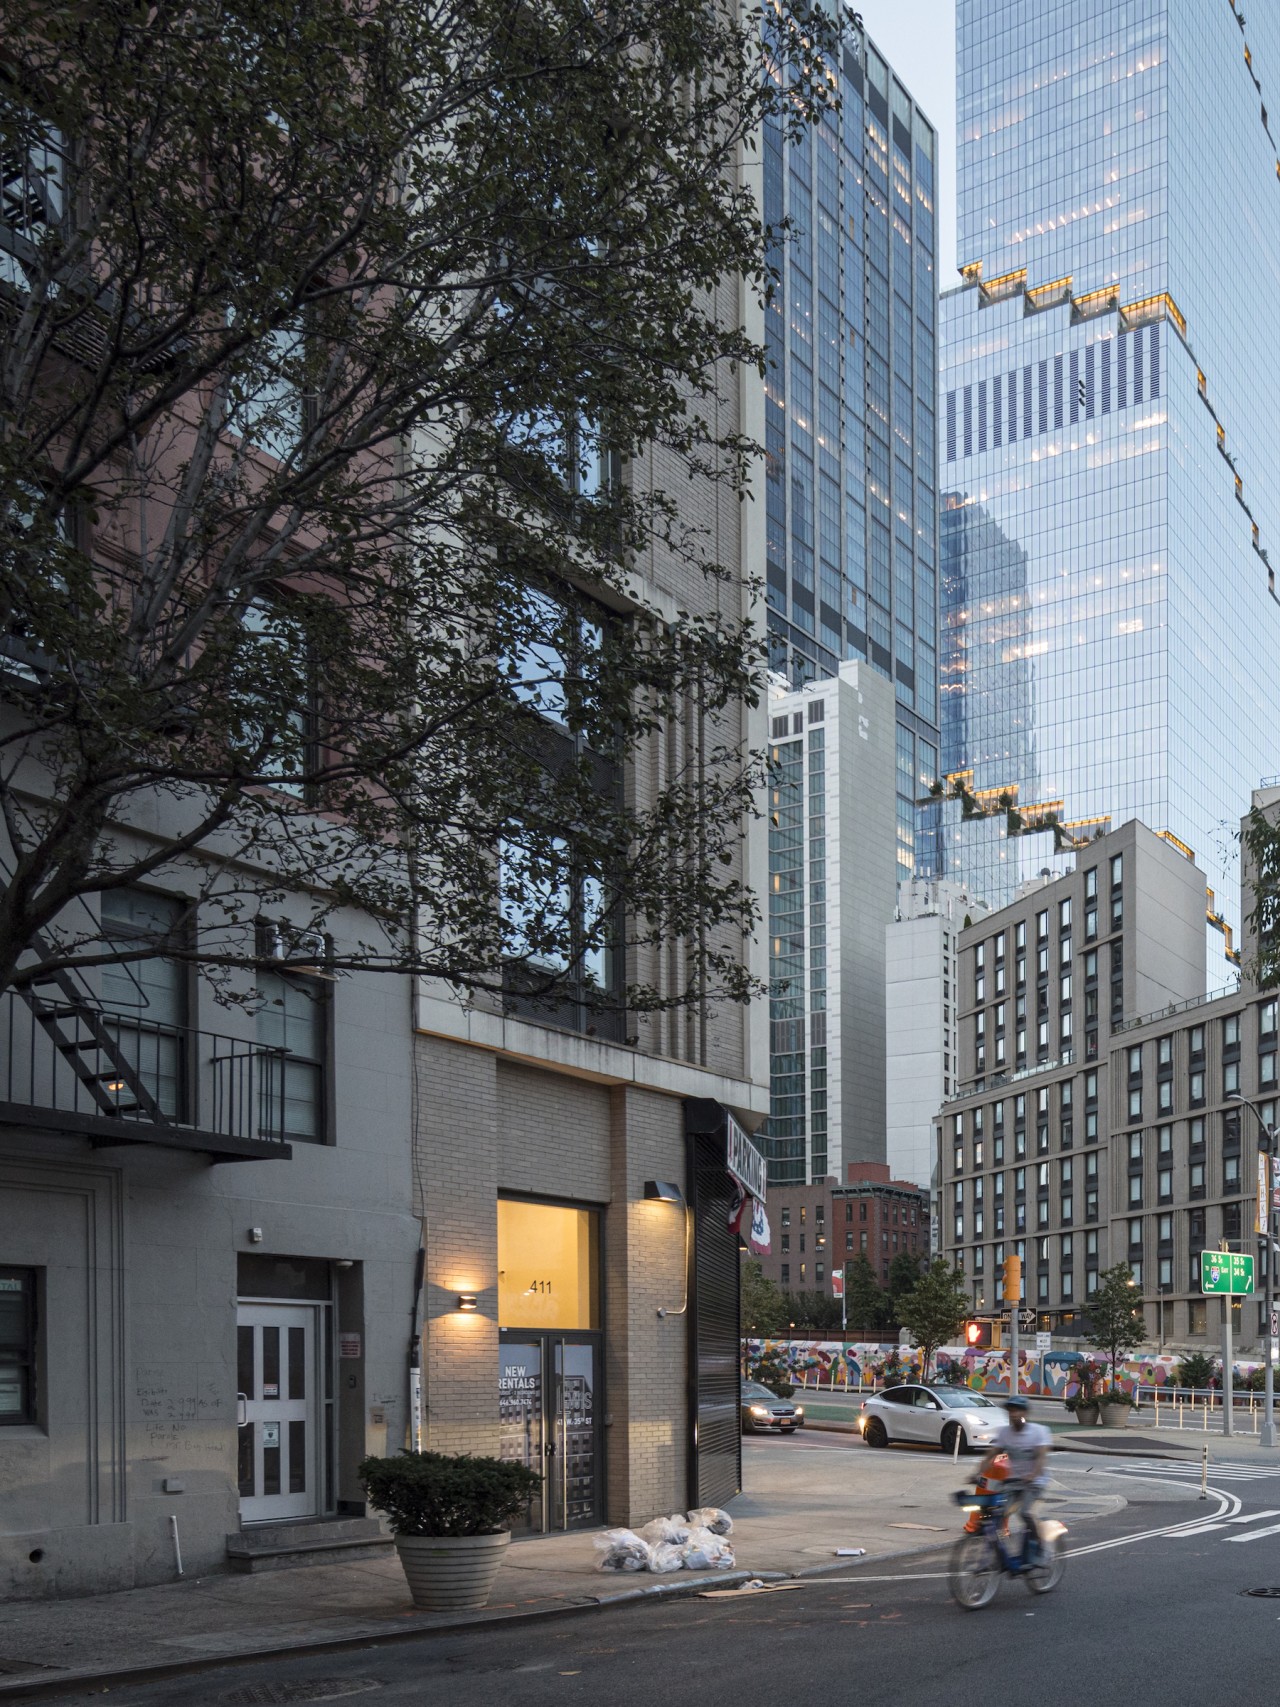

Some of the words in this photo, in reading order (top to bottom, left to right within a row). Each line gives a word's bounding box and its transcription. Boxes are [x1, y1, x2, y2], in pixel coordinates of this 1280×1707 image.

[733, 1123, 762, 1195] PARKING
[529, 1280, 551, 1294] 411
[505, 1366, 526, 1377] NEW
[499, 1378, 536, 1389] RENTALS
